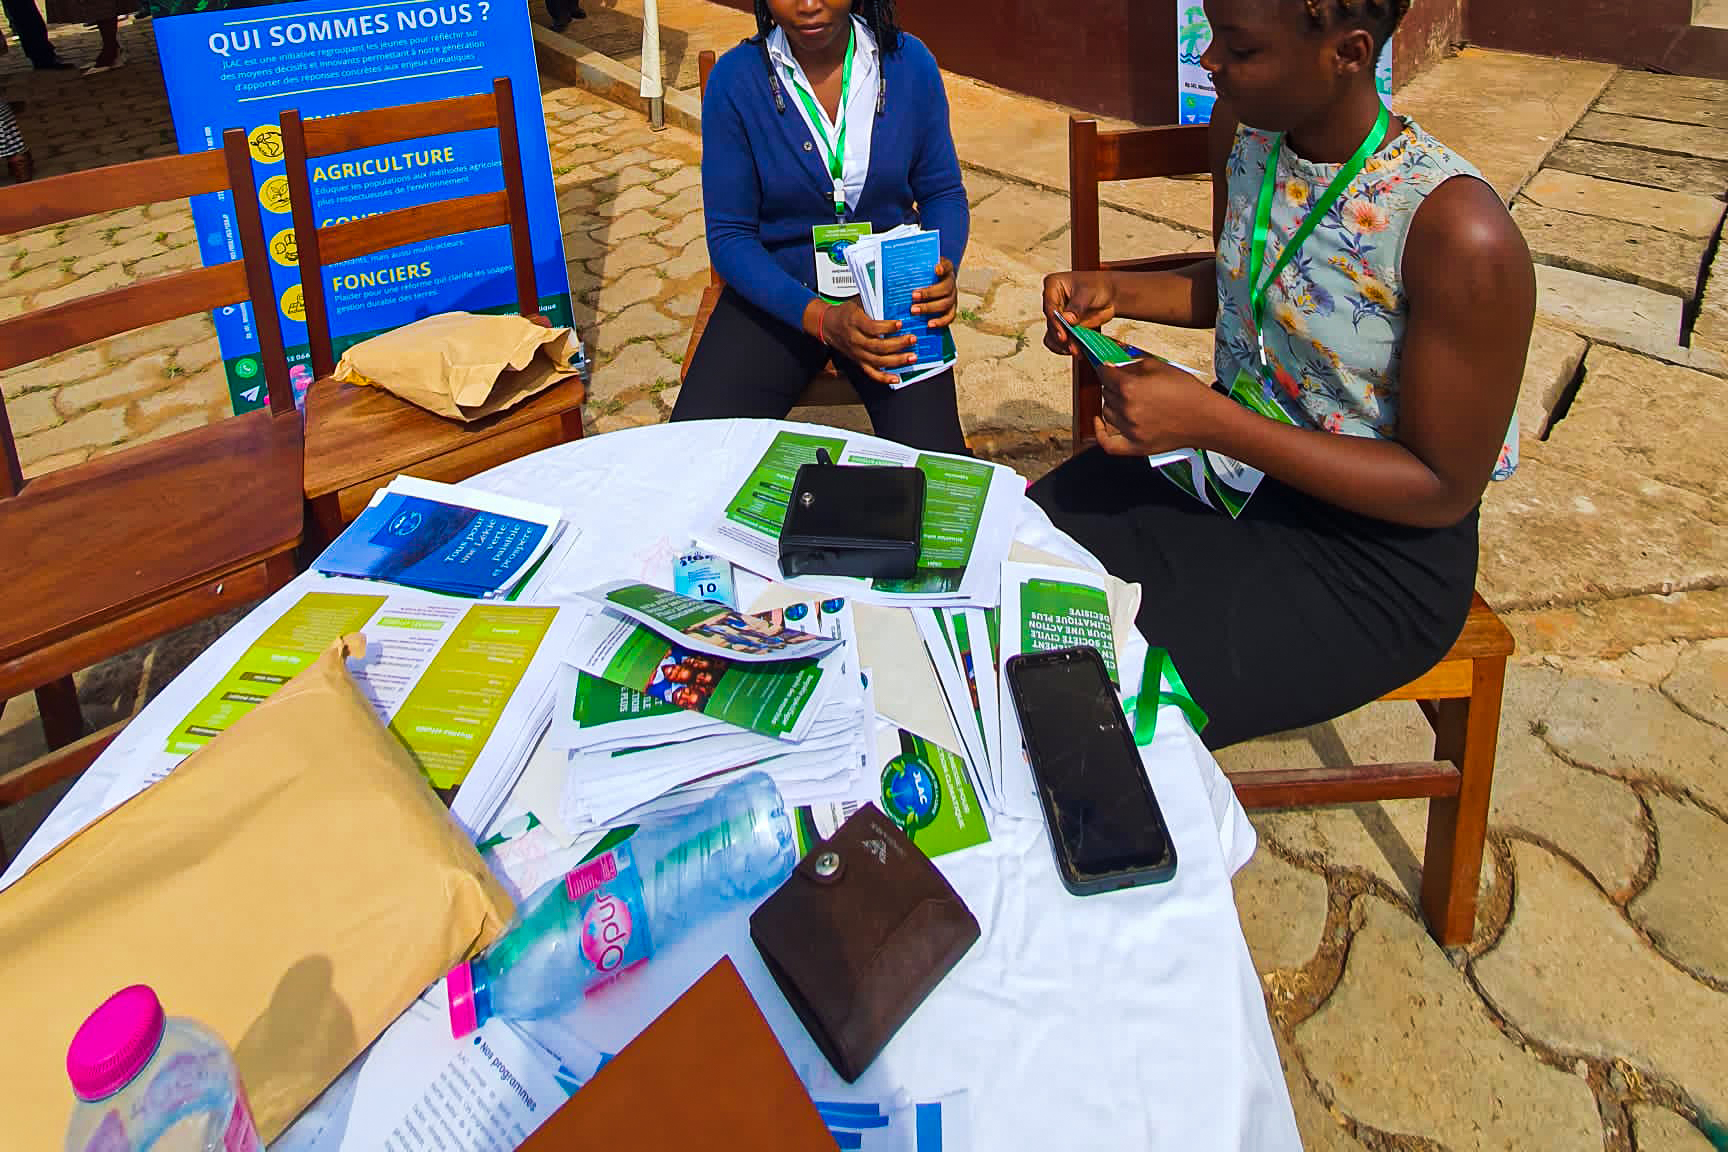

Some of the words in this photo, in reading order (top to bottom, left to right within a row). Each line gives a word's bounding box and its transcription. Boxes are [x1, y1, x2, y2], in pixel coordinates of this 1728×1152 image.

[208, 28, 261, 57] QUI
[269, 13, 390, 47] SOMMES
[396, 4, 473, 30] NOUS
[478, 1, 490, 21] ?
[260, 56, 277, 64] une
[410, 36, 429, 47] pour
[220, 73, 236, 81] des
[283, 76, 300, 84] des
[312, 146, 455, 184] AGRICULTURE
[332, 261, 432, 292] FONCIERS
[363, 290, 382, 298] pour
[466, 516, 485, 540] pour
[1031, 612, 1054, 622] PLUS
[1056, 616, 1112, 631] CLIMATIQUE
[1028, 620, 1062, 632] ACTION
[1065, 626, 1085, 636] UNE
[1030, 630, 1060, 642] CIVILE
[1087, 630, 1112, 640] POUR
[1102, 641, 1113, 650] ET
[912, 771, 928, 805] JLAC
[596, 893, 626, 972] Opur
[490, 1056, 536, 1112] programmes
